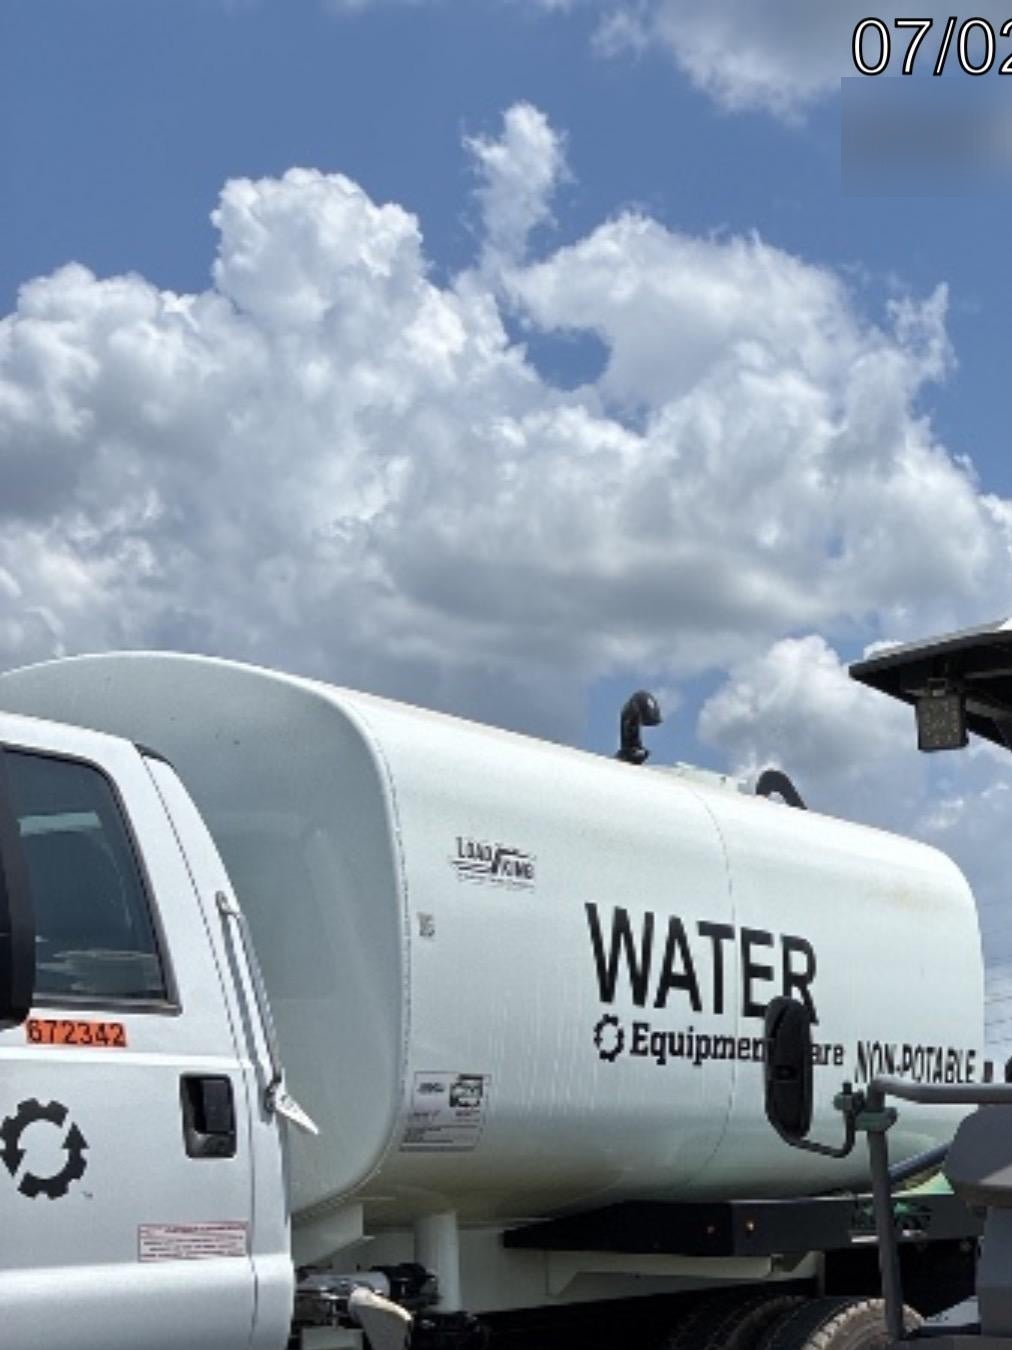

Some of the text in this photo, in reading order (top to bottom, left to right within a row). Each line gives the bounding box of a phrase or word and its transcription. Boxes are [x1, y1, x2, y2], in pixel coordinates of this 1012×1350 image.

[585, 902, 820, 1026] WATER
[27, 1019, 126, 1047] 672342
[854, 1040, 977, 1084] NON-POTABLE
